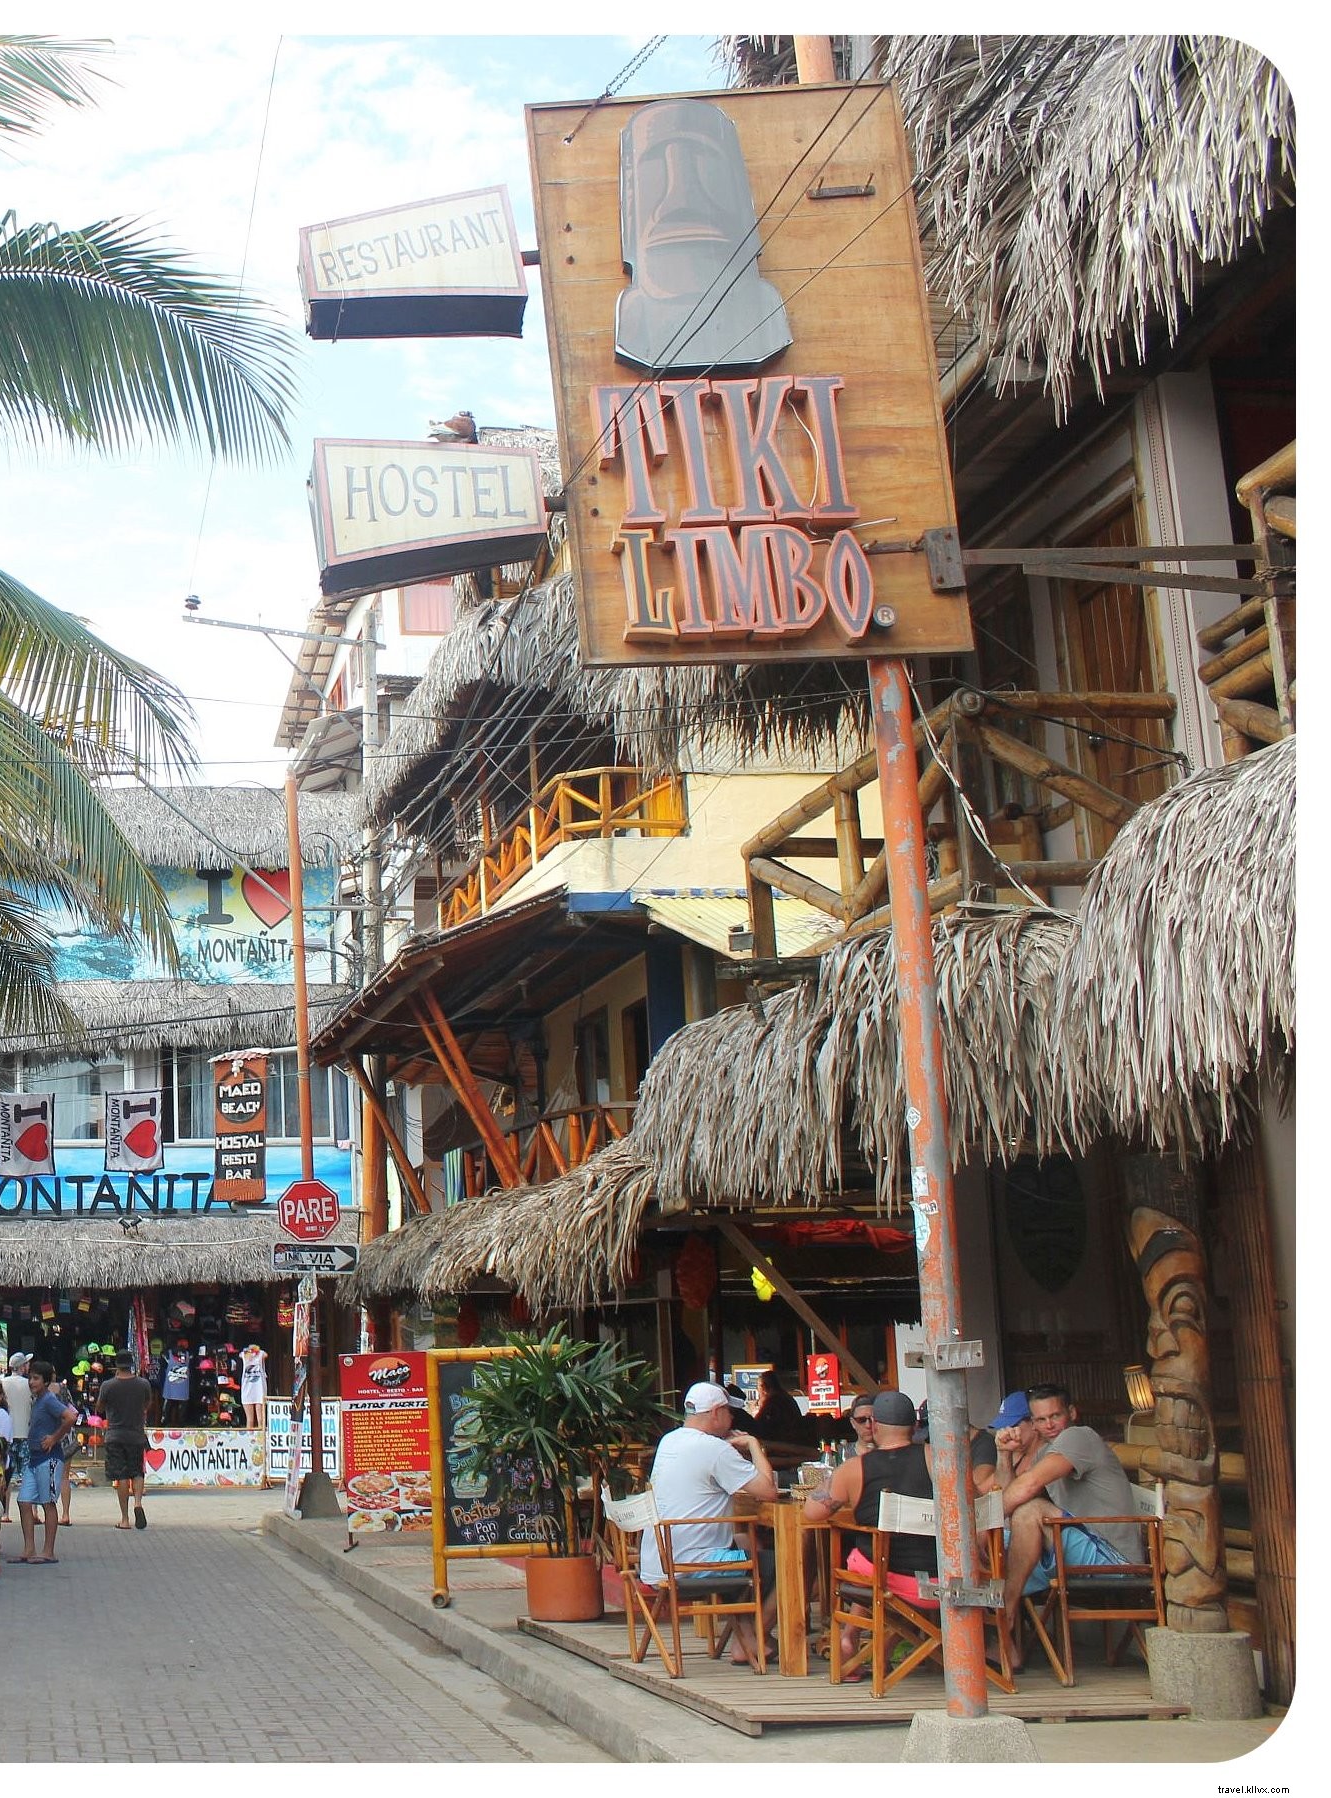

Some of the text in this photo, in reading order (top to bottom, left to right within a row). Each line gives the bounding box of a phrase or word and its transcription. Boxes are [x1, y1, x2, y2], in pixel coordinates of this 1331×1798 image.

[319, 207, 506, 286] RESTAURANT
[591, 376, 861, 527] TIKI
[344, 463, 528, 523] HOSTEL
[610, 524, 874, 645] LIMBO
[196, 868, 235, 924] I
[13, 1100, 48, 1124] I
[122, 1097, 157, 1119] I
[221, 1101, 261, 1114] BEACH
[0, 1101, 14, 1163] MONTAÑITA
[110, 1098, 122, 1160] MONTAÑITA
[216, 1134, 264, 1150] HOSTAL
[221, 1153, 257, 1166] RESTO
[225, 1168, 252, 1180] BAR
[283, 1197, 334, 1225] PARE
[309, 1253, 333, 1264] VIA
[271, 1405, 280, 1415] LO
[325, 1405, 335, 1415] EN
[349, 1402, 386, 1410] PLATOS
[271, 1435, 283, 1447] SE
[324, 1435, 336, 1447] EN
[169, 1441, 248, 1471] MONTAÑITA
[451, 1500, 500, 1527] Pastas
[476, 1522, 496, 1534] Pan
